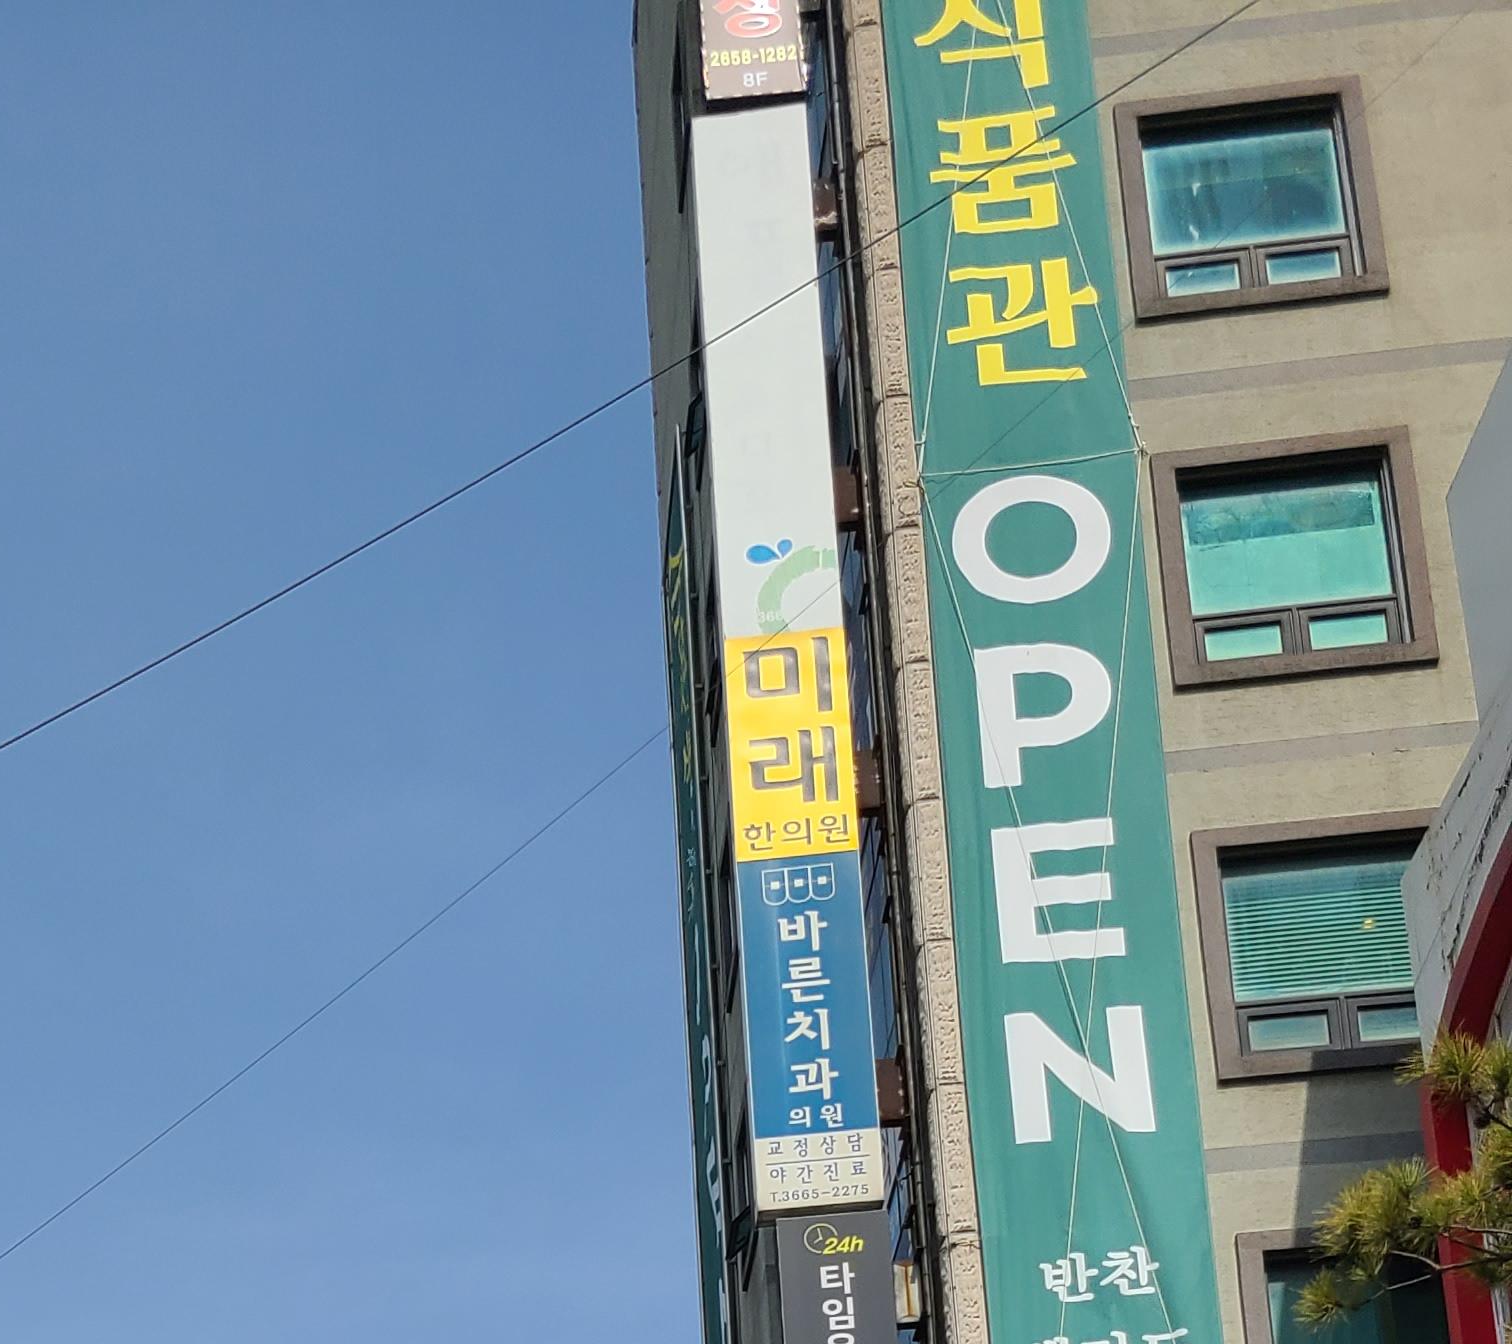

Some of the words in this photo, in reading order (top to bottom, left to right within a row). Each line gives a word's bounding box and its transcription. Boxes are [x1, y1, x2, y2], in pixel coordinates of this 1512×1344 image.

[710, 44, 797, 67] 2658-1282
[743, 72, 768, 88] 8F
[743, 636, 839, 803] 미래
[952, 475, 1157, 1145] OPEN
[743, 814, 850, 852] 한의원
[778, 910, 839, 1100] 바른치과
[788, 1103, 845, 1128] 의원
[767, 1132, 864, 1157] 교정상담
[769, 1159, 867, 1185] 야간진료
[770, 1183, 870, 1204] T.3665-2275
[822, 1236, 864, 1255] 24h
[1039, 1245, 1160, 1302] 반찬
